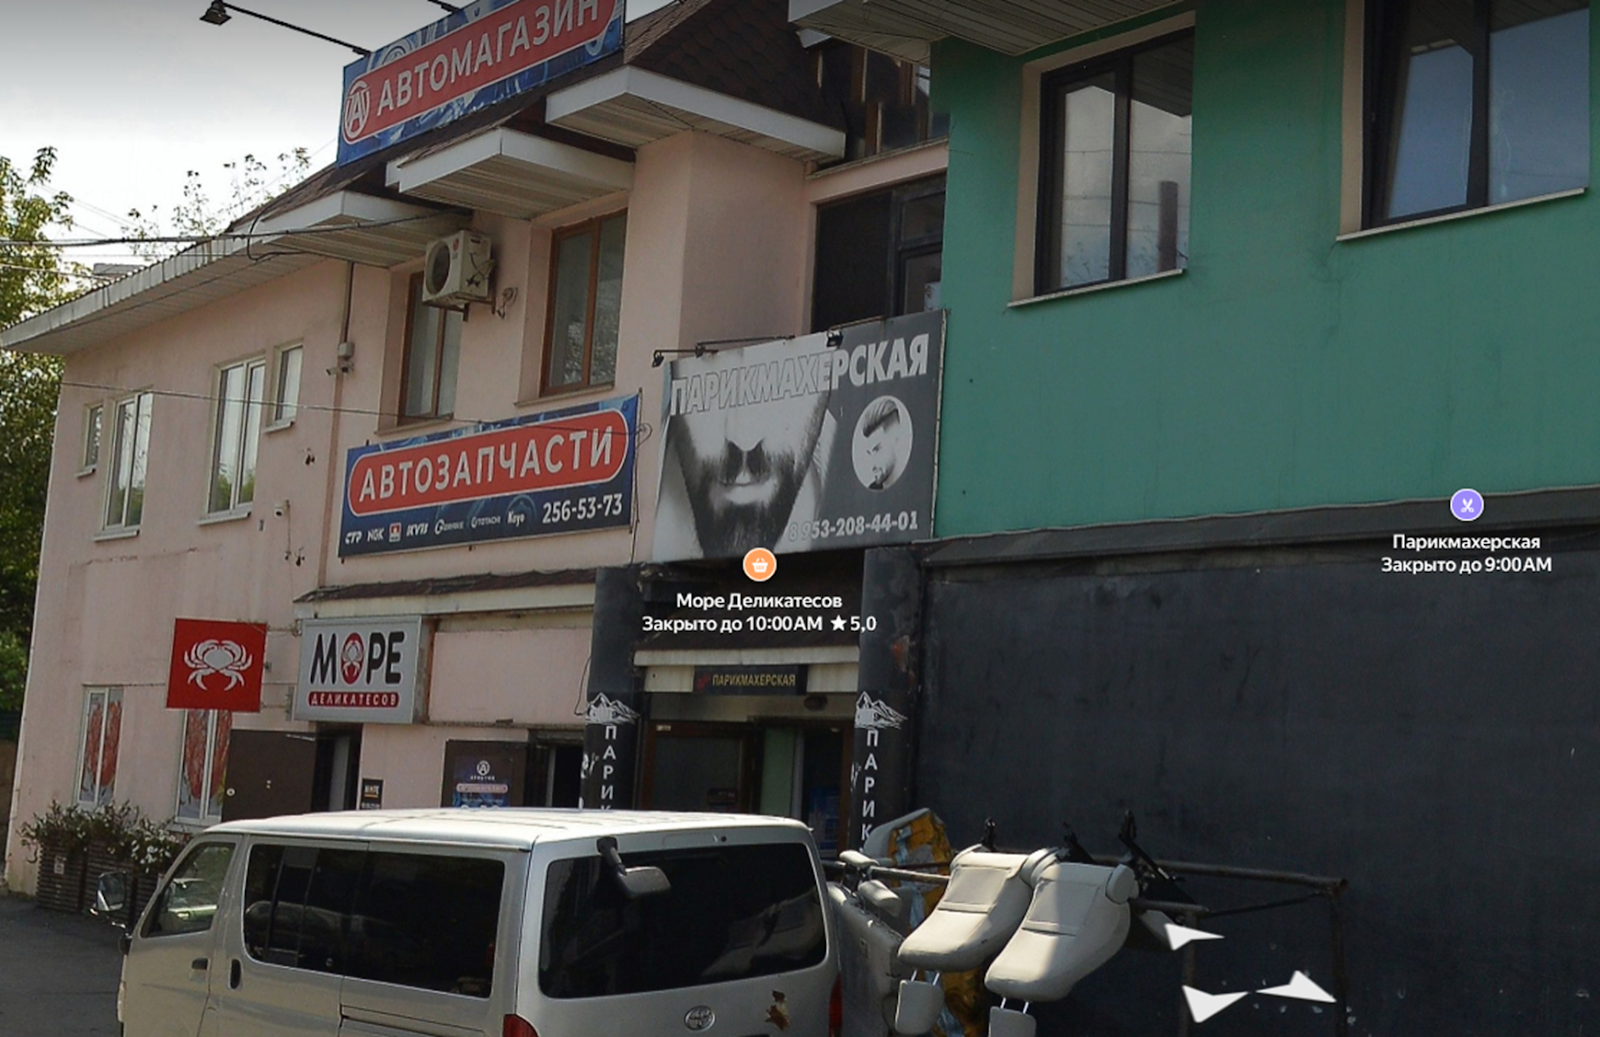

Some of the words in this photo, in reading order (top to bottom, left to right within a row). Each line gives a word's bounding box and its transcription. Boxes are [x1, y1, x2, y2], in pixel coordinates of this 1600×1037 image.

[377, 0, 599, 117] АВТОМАГАЗИН
[670, 333, 930, 416] ПАРИКМАХЕРСКАЯ
[359, 425, 613, 502] АВТОЗАПЧАСТИ
[542, 493, 623, 525] 256-53-73
[802, 511, 919, 539] 953-208-44-01
[310, 631, 405, 685] МОРЕ
[712, 674, 796, 687] ПАРИКМАХЕРСКАЯ
[311, 692, 397, 706] ДЕЛИКАТЕСОВ
[860, 729, 879, 850] ПАРИК
